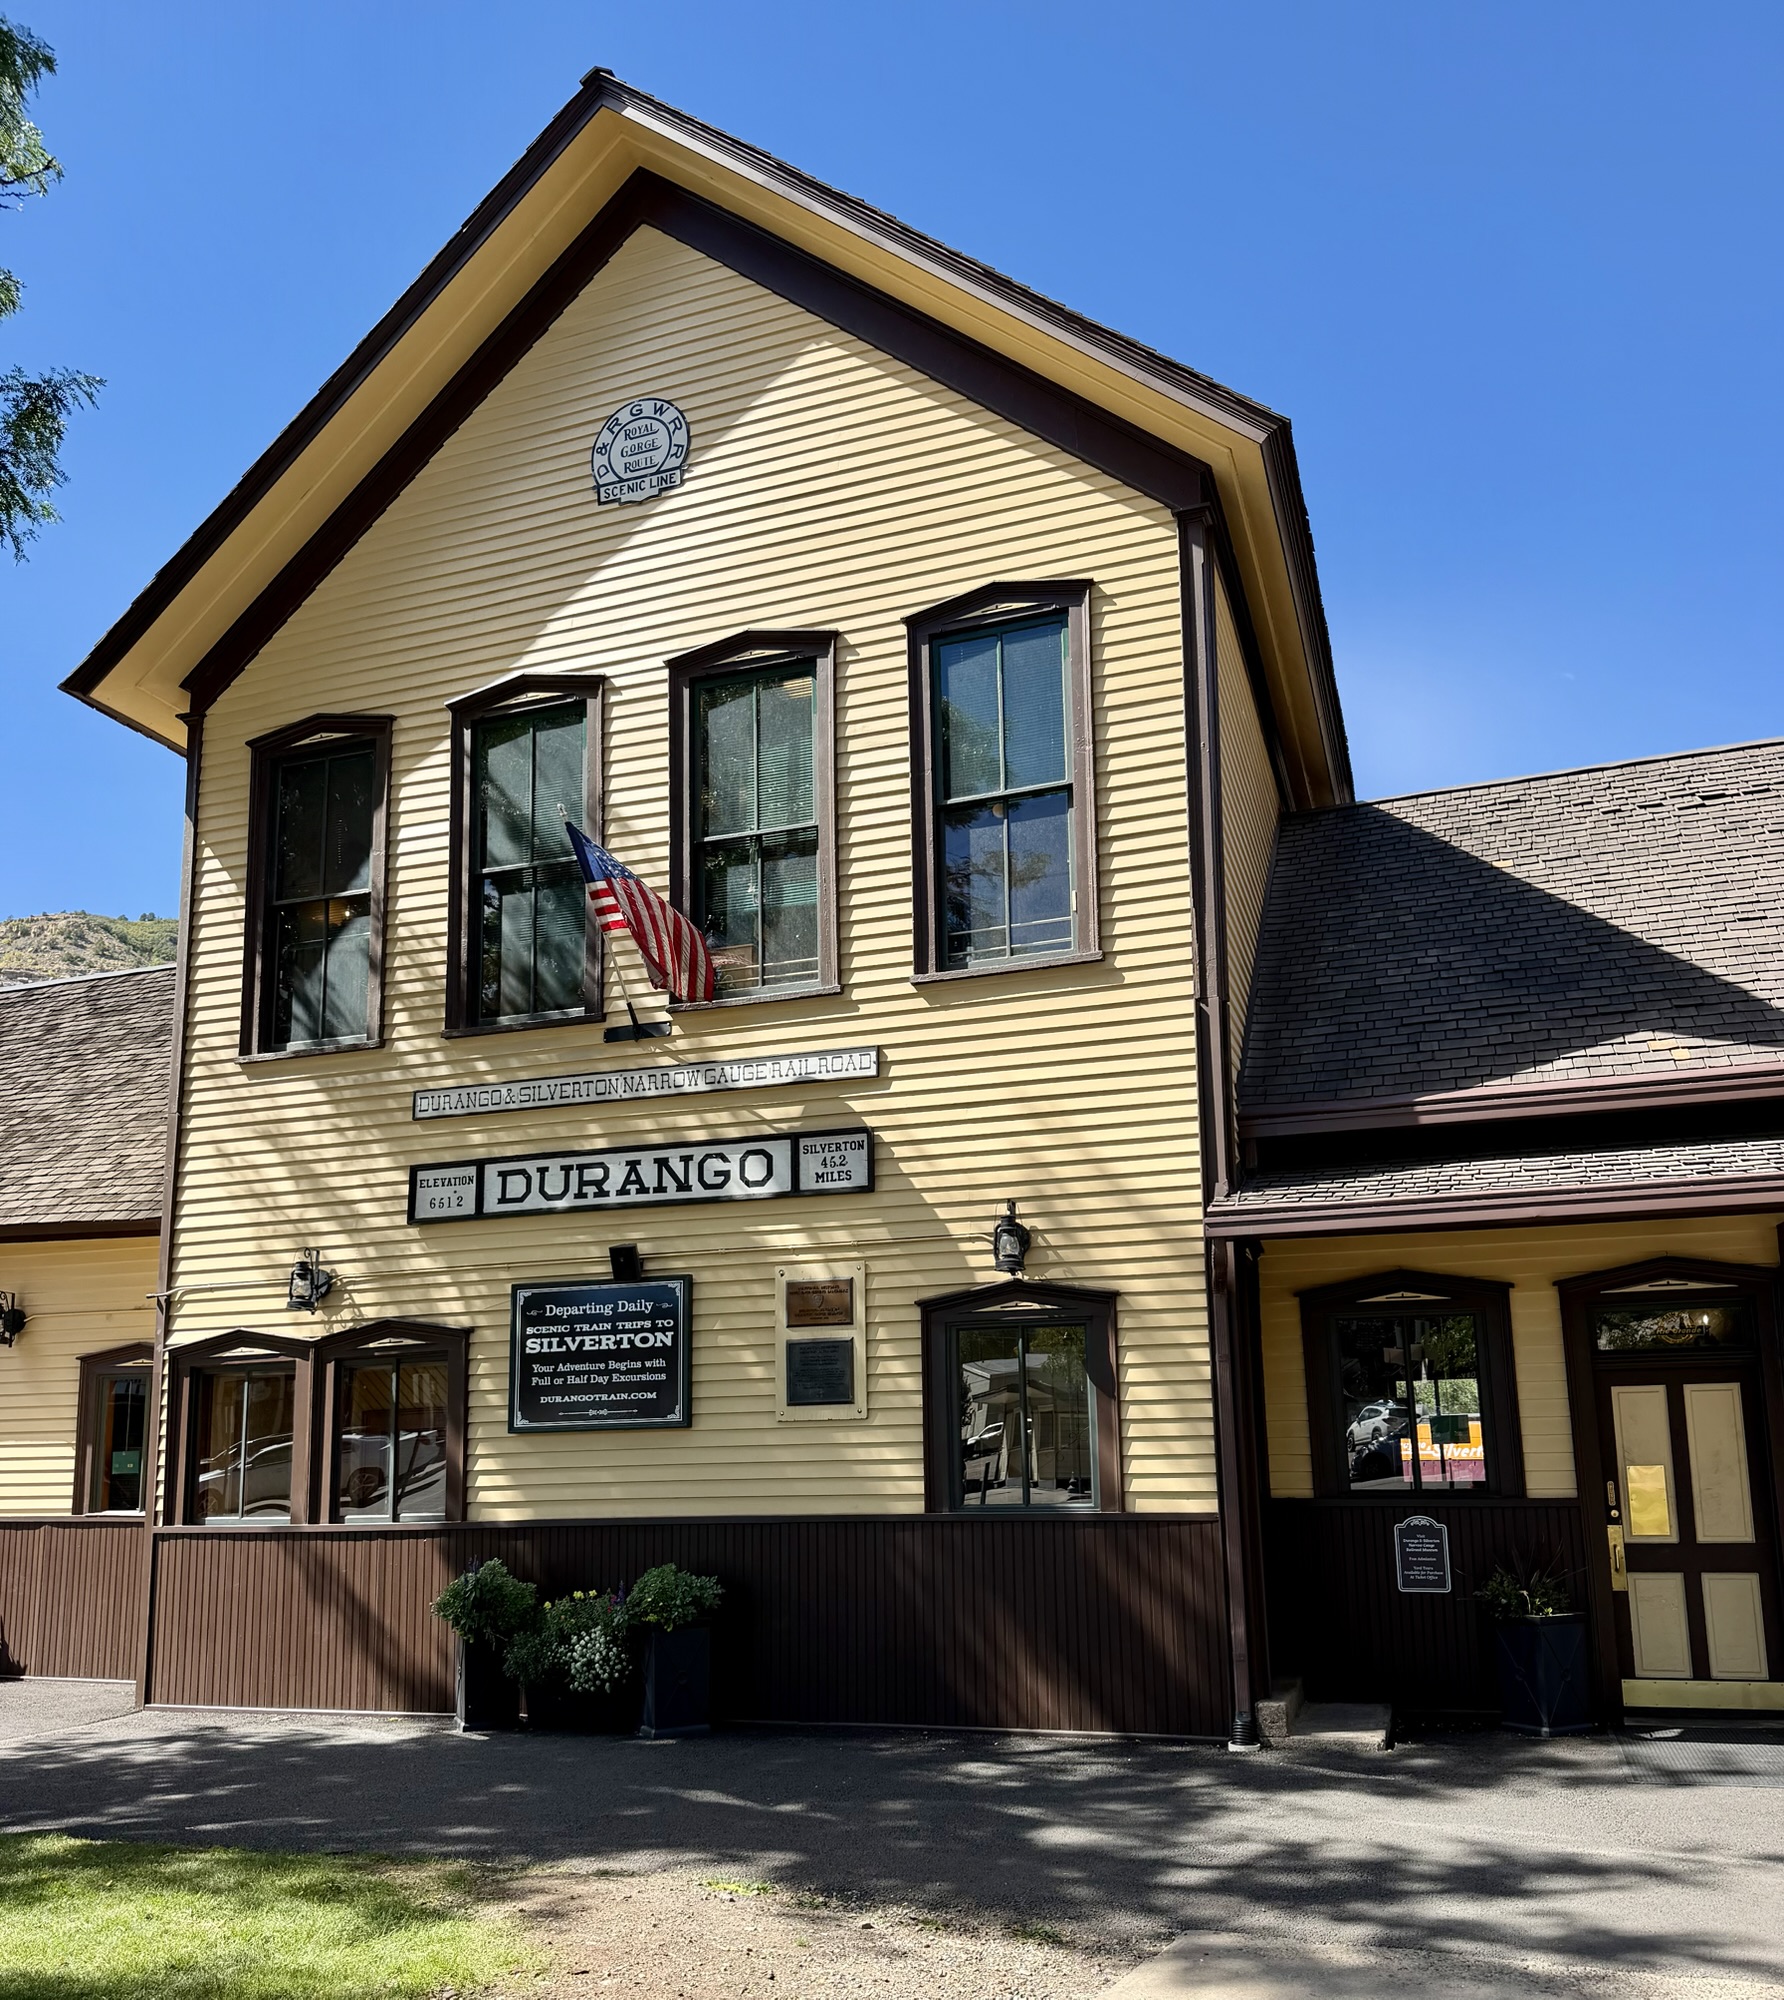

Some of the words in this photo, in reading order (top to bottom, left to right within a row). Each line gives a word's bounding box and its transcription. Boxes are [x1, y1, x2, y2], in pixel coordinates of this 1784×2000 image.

[624, 423, 659, 441] ROYAL
[621, 438, 662, 458] GORGE
[624, 455, 659, 474] ROUTE
[604, 480, 646, 499] SCENIC
[650, 472, 676, 488] LINE
[418, 1090, 502, 1112] DURANGO
[504, 1088, 516, 1104] &
[519, 1078, 620, 1103] SILVERTON
[622, 1070, 700, 1093] NARROW
[704, 1063, 767, 1085] GAUGE
[771, 1053, 872, 1078] RAILROAD
[802, 1140, 864, 1154] SILVERTON
[820, 1155, 848, 1168] 45.2
[419, 1176, 474, 1188] ELEVATION
[497, 1148, 774, 1205] DURANGO
[815, 1170, 852, 1184] MILES
[430, 1196, 464, 1209] 6512
[545, 1302, 614, 1318] Departing
[617, 1300, 654, 1314] Daily
[526, 1325, 570, 1334] SCENIC
[574, 1322, 612, 1332] TRAIN
[616, 1320, 652, 1330] TRIPS
[656, 1319, 674, 1328] TO
[526, 1332, 674, 1354] SILVERTON
[532, 1364, 554, 1373] Your
[557, 1362, 606, 1372] Adventure
[608, 1360, 642, 1370] Begins
[645, 1358, 666, 1368] with
[532, 1376, 551, 1386] Full
[554, 1378, 564, 1386] or
[567, 1374, 588, 1384] Half
[590, 1374, 609, 1384] Day
[612, 1372, 666, 1382] Excursions
[540, 1392, 657, 1404] DURANGOTRAIN.COM
